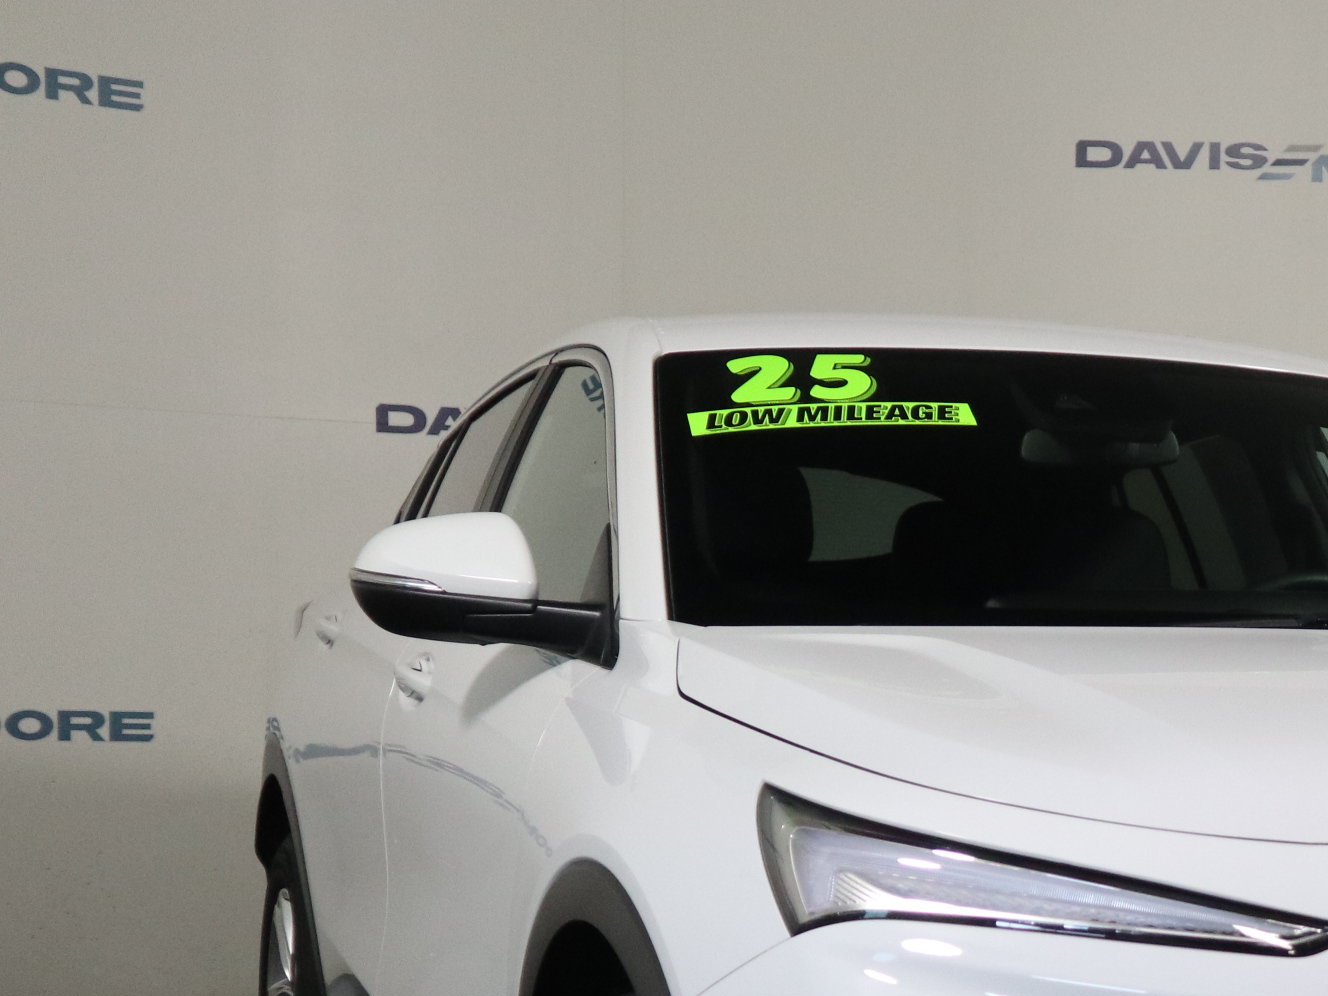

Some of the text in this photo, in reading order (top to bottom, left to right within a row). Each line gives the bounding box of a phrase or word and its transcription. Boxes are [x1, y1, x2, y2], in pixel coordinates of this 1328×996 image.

[1074, 139, 1269, 171] DAVIS
[726, 354, 877, 404] 25
[705, 403, 961, 431] LOW MILEAGE
[0, 709, 155, 742] ORE
